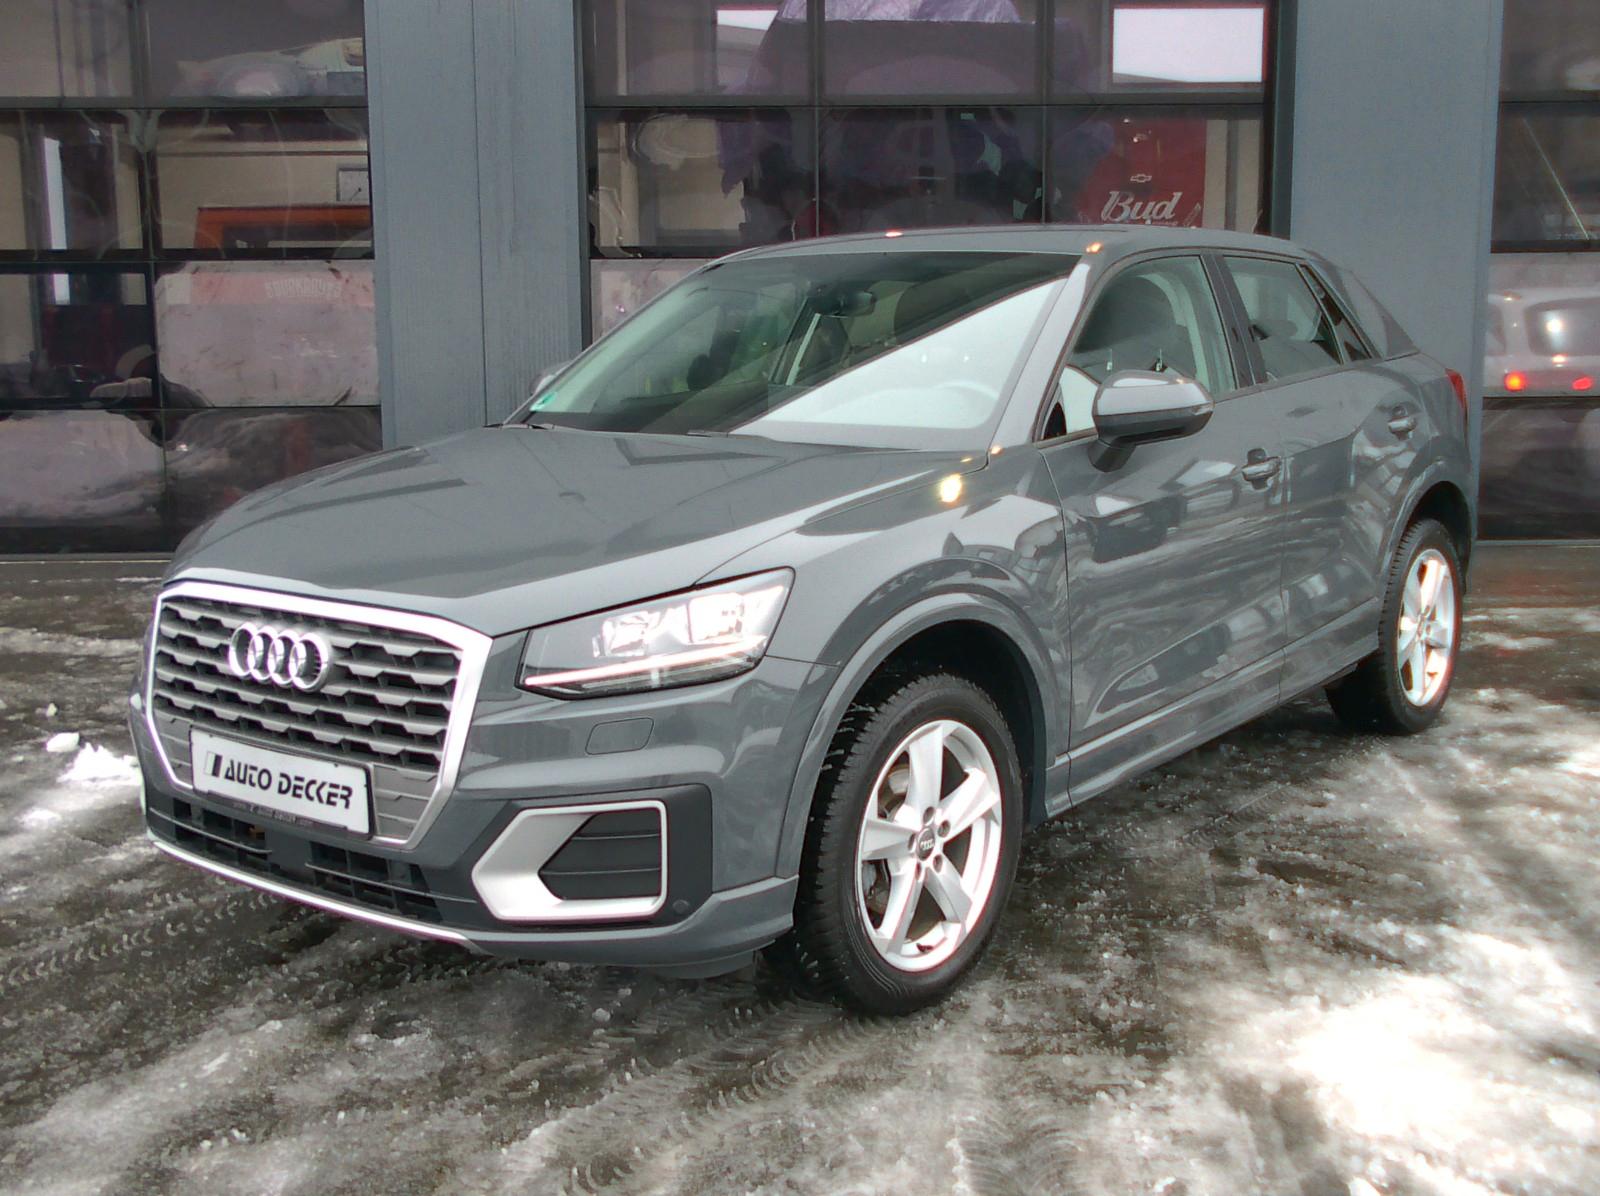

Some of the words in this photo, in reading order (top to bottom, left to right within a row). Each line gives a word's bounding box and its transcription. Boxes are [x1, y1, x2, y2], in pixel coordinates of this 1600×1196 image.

[1101, 191, 1183, 221] Bud
[224, 759, 272, 790] AUTO
[278, 772, 353, 810] DECKER
